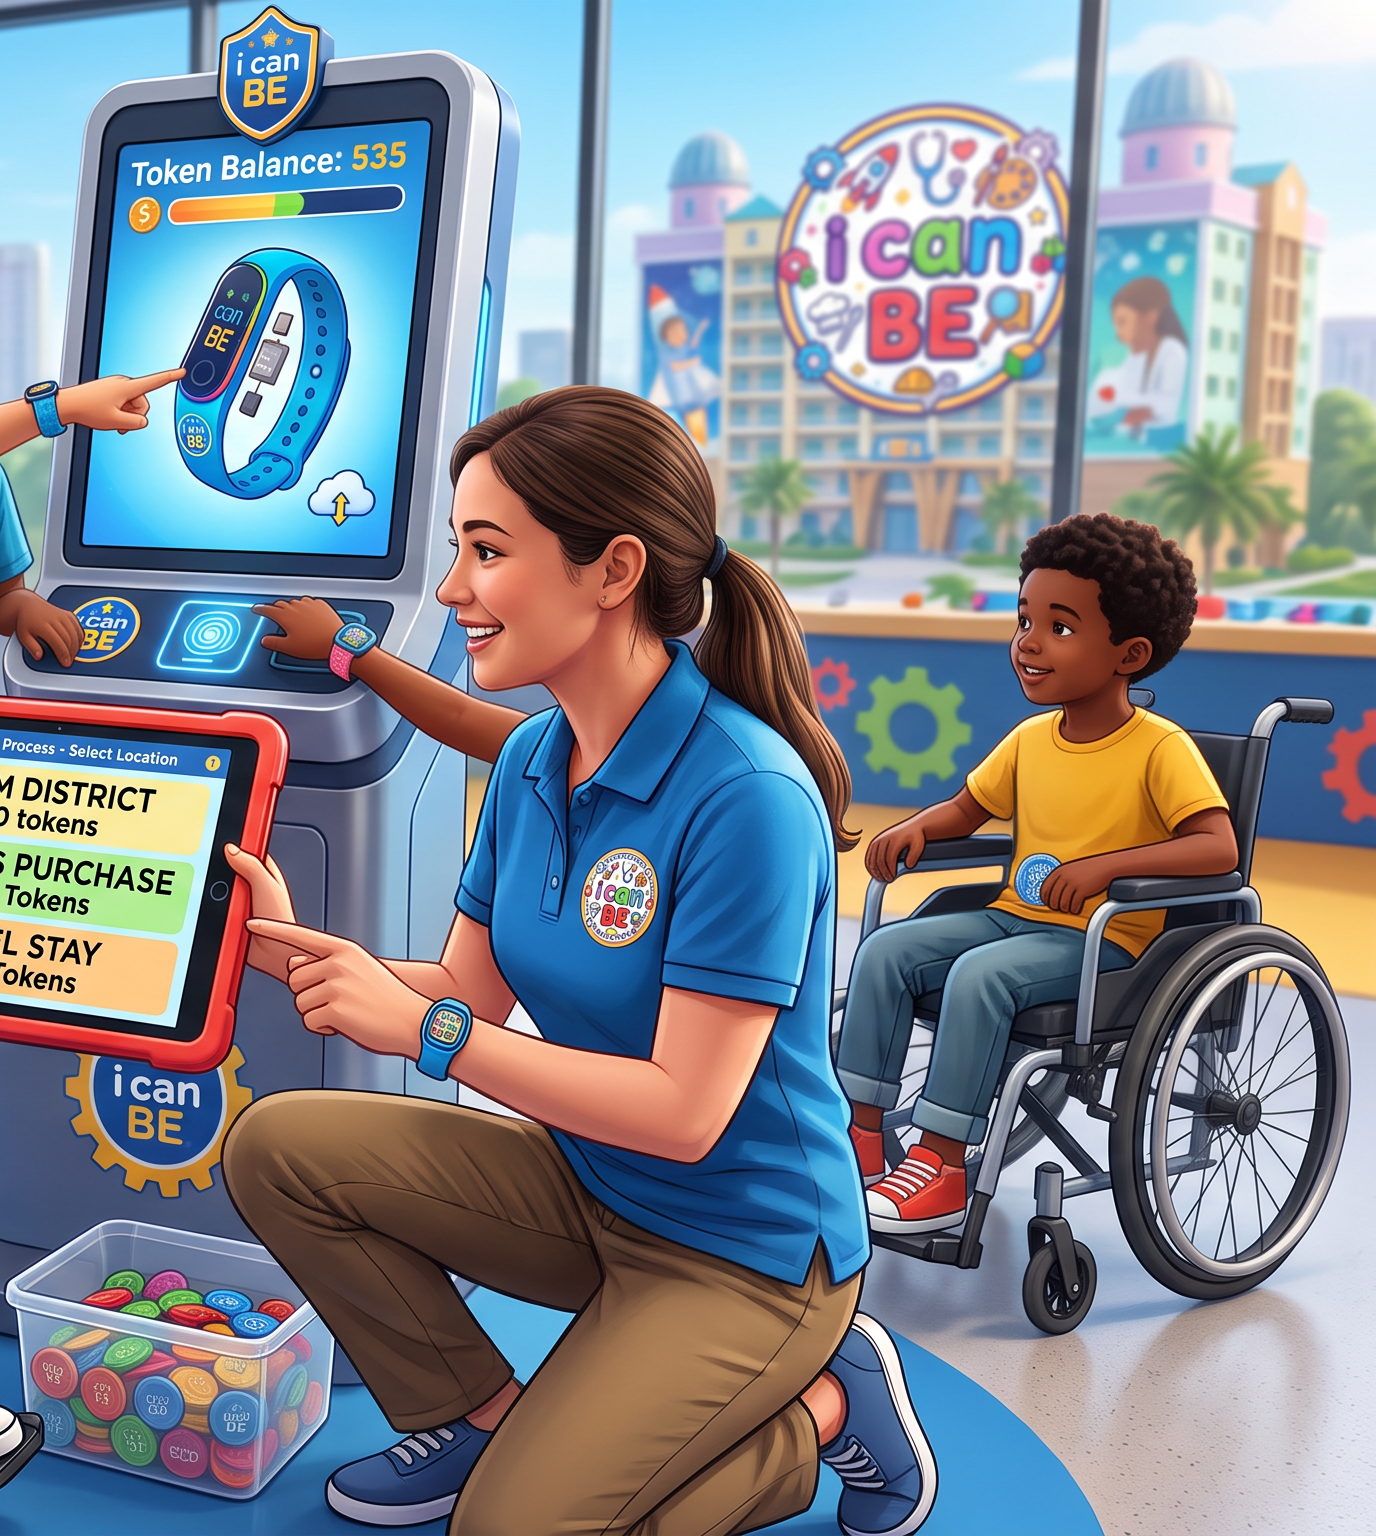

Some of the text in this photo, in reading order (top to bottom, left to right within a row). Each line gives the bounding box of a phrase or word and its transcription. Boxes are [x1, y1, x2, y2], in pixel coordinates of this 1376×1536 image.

[236, 51, 300, 77] i can
[243, 75, 288, 108] BE
[131, 141, 407, 187] Token Balance: 535
[825, 214, 1023, 285] i can
[204, 325, 235, 352] BE
[866, 284, 980, 364] BE
[85, 616, 129, 630] can
[80, 628, 119, 651] BE
[2, 738, 55, 755] Process
[69, 743, 112, 761] Select
[116, 749, 178, 767] Location
[22, 776, 157, 813] DISTRICT
[17, 808, 99, 837] tokens
[13, 853, 176, 896] PURCHASE
[5, 884, 90, 915] Tokens
[594, 880, 645, 909] i can
[600, 904, 631, 929] BE
[27, 933, 103, 967] STAY
[113, 1063, 201, 1109] i can
[128, 1104, 184, 1146] BE
